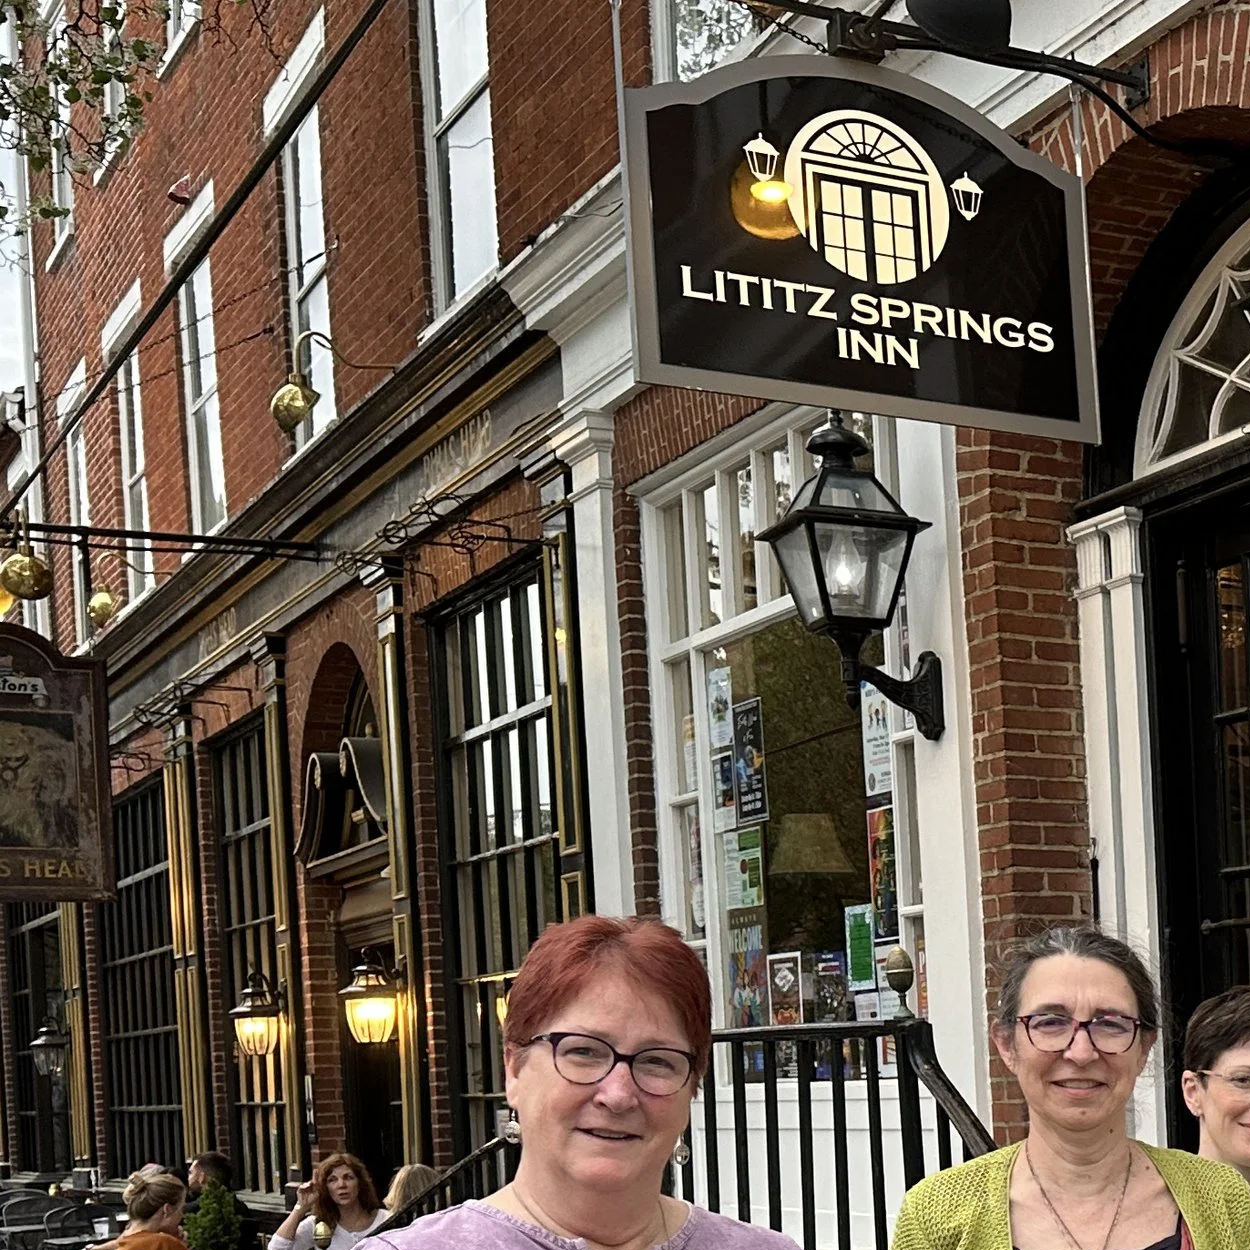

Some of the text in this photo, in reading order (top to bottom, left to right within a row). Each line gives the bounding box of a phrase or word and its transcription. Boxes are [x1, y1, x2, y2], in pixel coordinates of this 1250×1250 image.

[680, 264, 1055, 353] LITITZ SPRINGS
[836, 326, 921, 370] INN
